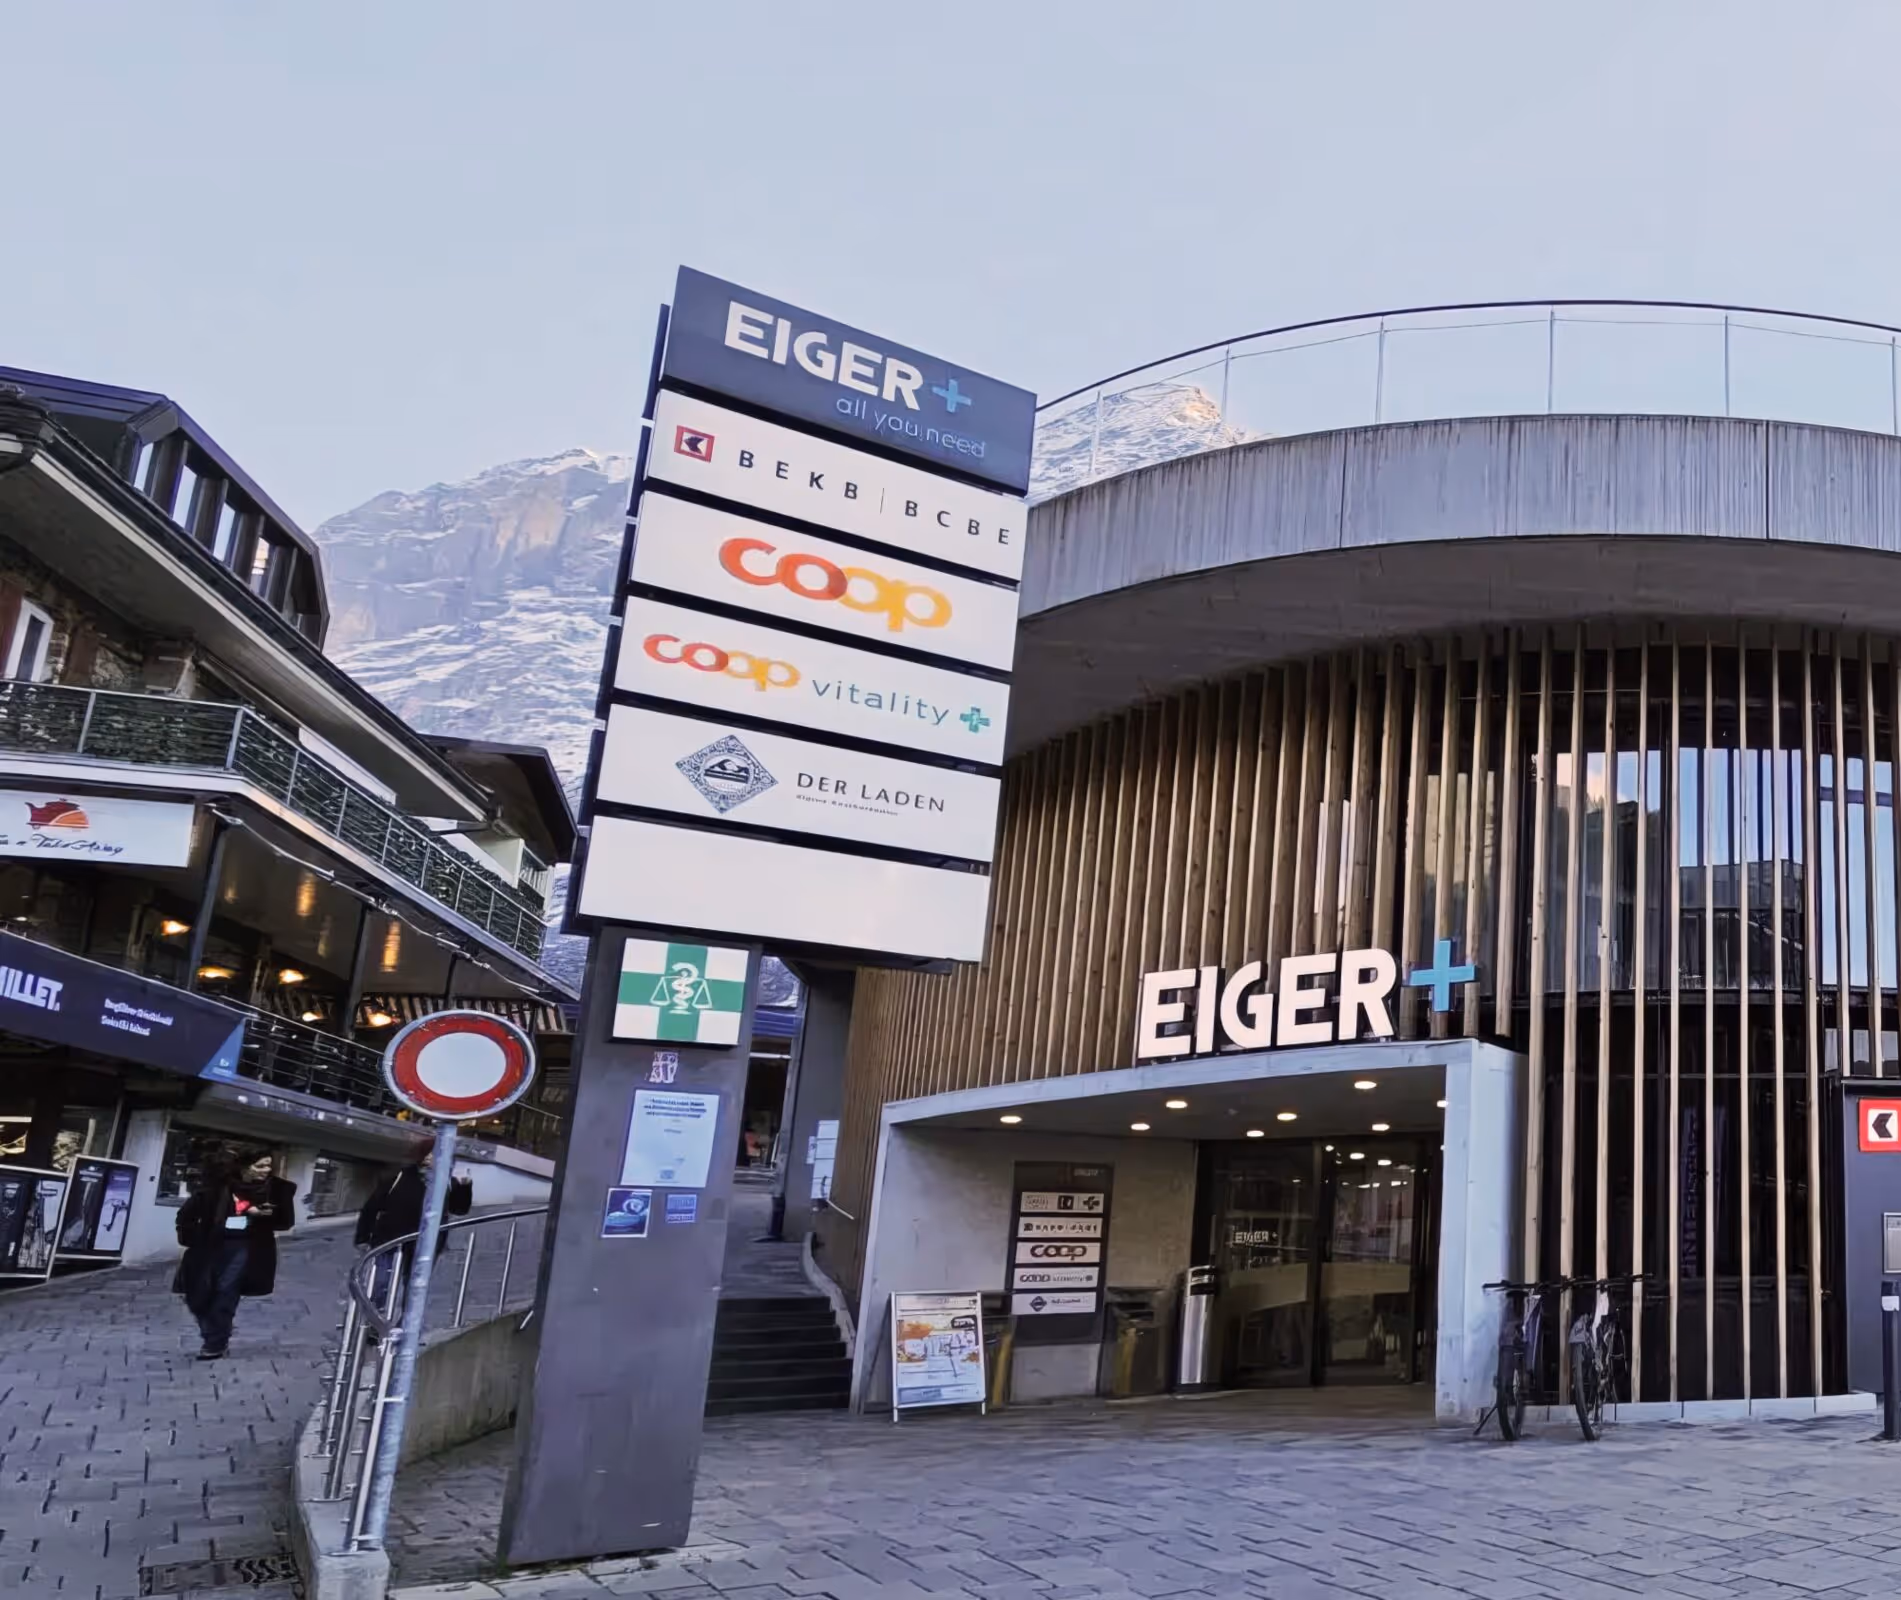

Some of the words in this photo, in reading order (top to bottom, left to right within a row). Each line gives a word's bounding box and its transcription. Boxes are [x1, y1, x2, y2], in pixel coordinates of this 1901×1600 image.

[835, 397, 867, 420] all
[873, 410, 919, 436] you
[925, 428, 986, 458] need
[718, 537, 952, 632] coop
[643, 633, 801, 692] coop
[811, 679, 950, 726] vitality
[796, 772, 848, 796] DER
[860, 784, 945, 813] LADEN
